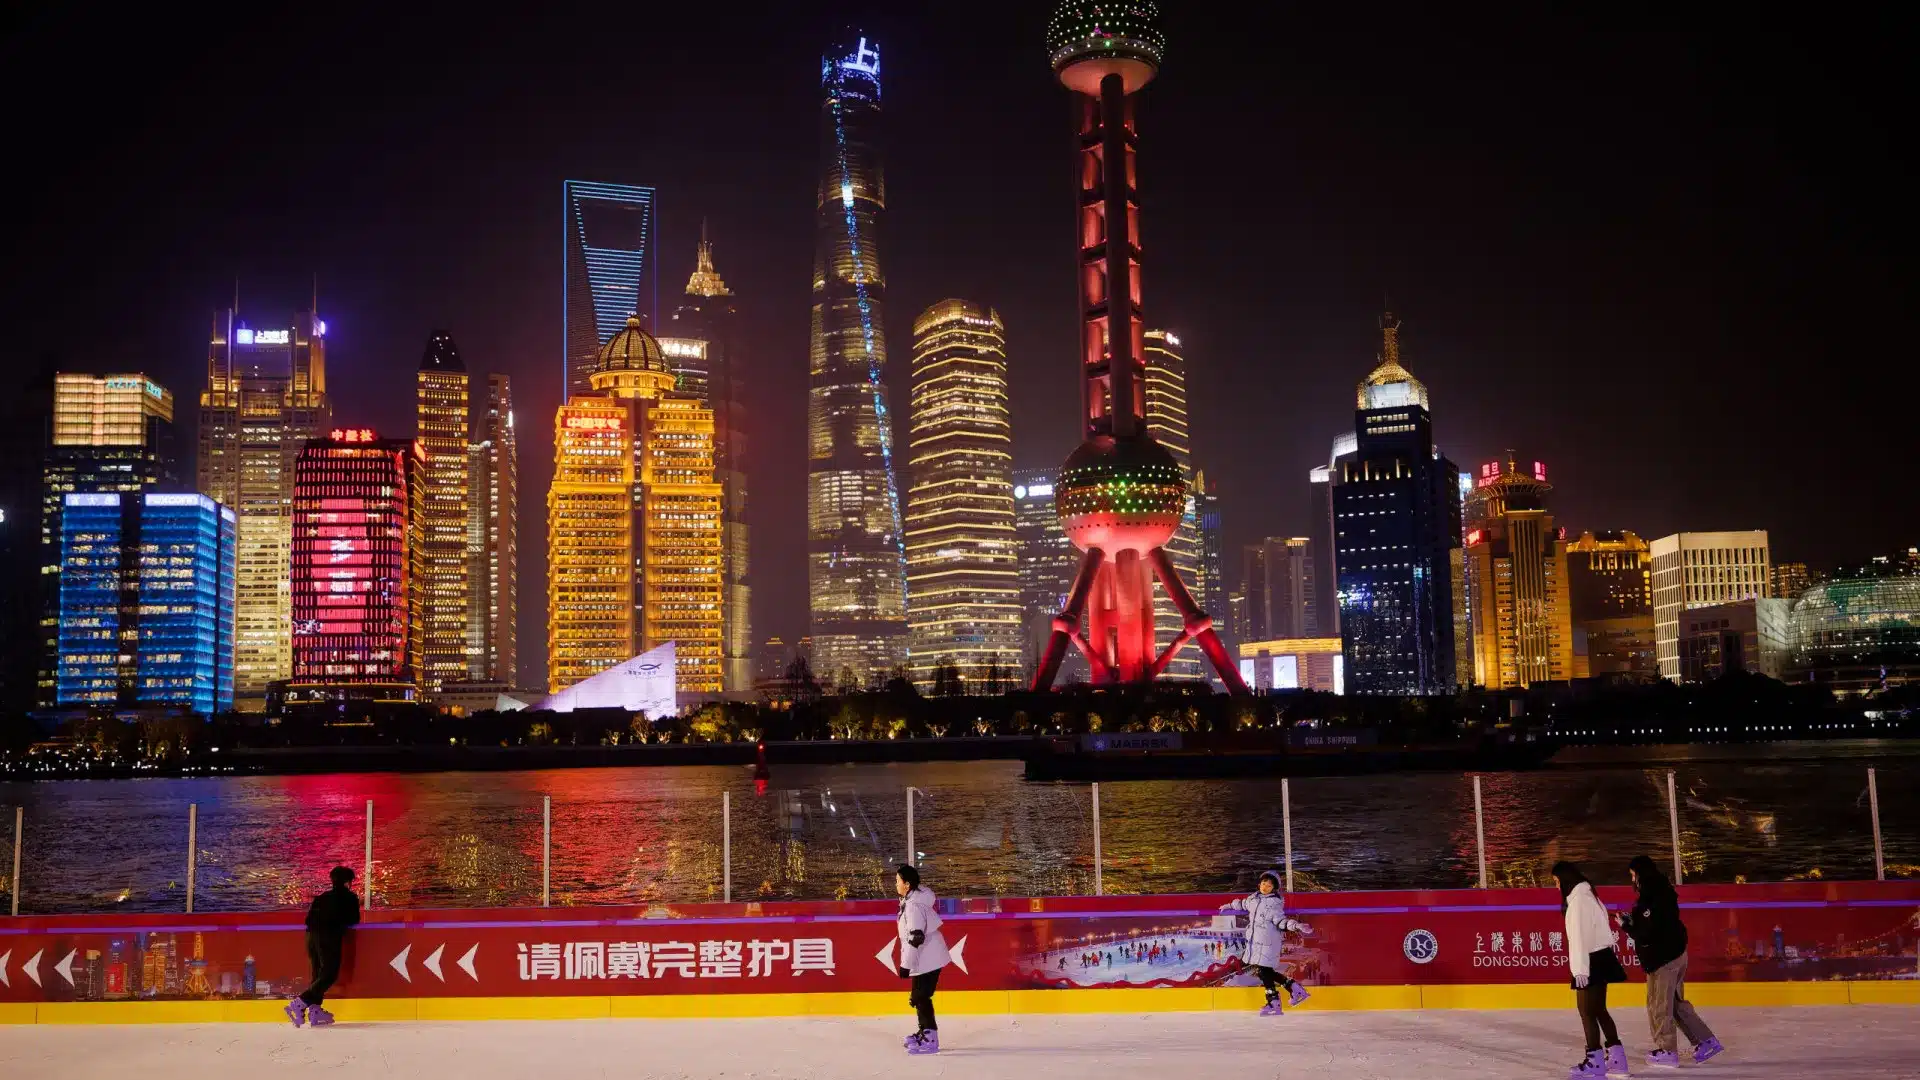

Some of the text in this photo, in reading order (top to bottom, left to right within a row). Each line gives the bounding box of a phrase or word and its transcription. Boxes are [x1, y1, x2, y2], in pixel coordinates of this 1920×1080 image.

[1111, 739, 1169, 749] MAERSK
[517, 938, 836, 980] 请佩戴完整护具
[1473, 955, 1549, 967] DONGSONG
